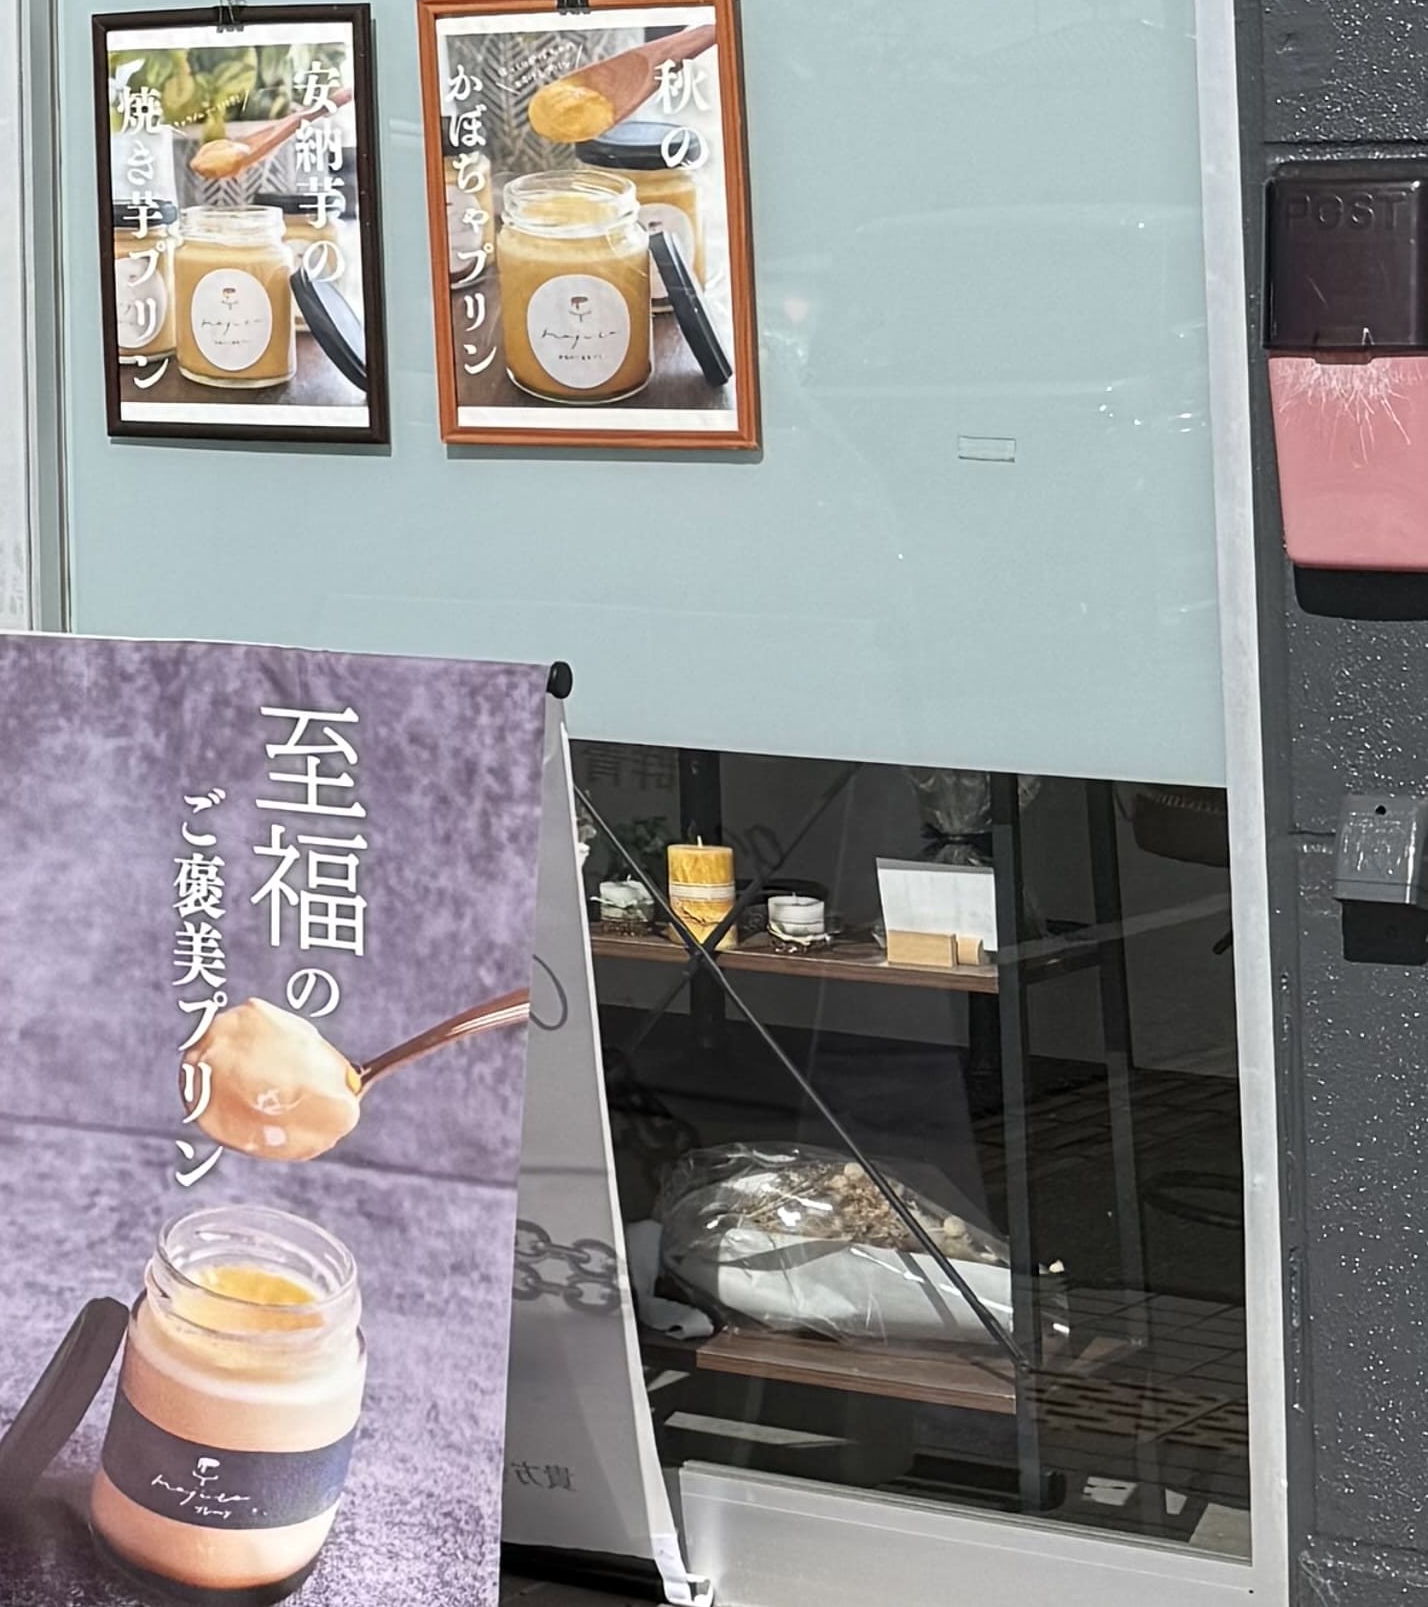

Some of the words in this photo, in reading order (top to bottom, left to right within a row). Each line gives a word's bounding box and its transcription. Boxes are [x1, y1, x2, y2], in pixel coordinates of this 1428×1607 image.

[117, 86, 169, 391] 焼き芋プリン
[293, 60, 346, 284] 安納芋の
[445, 64, 497, 377] かぼちゃプリン
[653, 58, 712, 171] 秋の
[1286, 190, 1408, 232] POST
[172, 787, 228, 1187] ご褒美プリン
[250, 705, 369, 1019] 至福の
